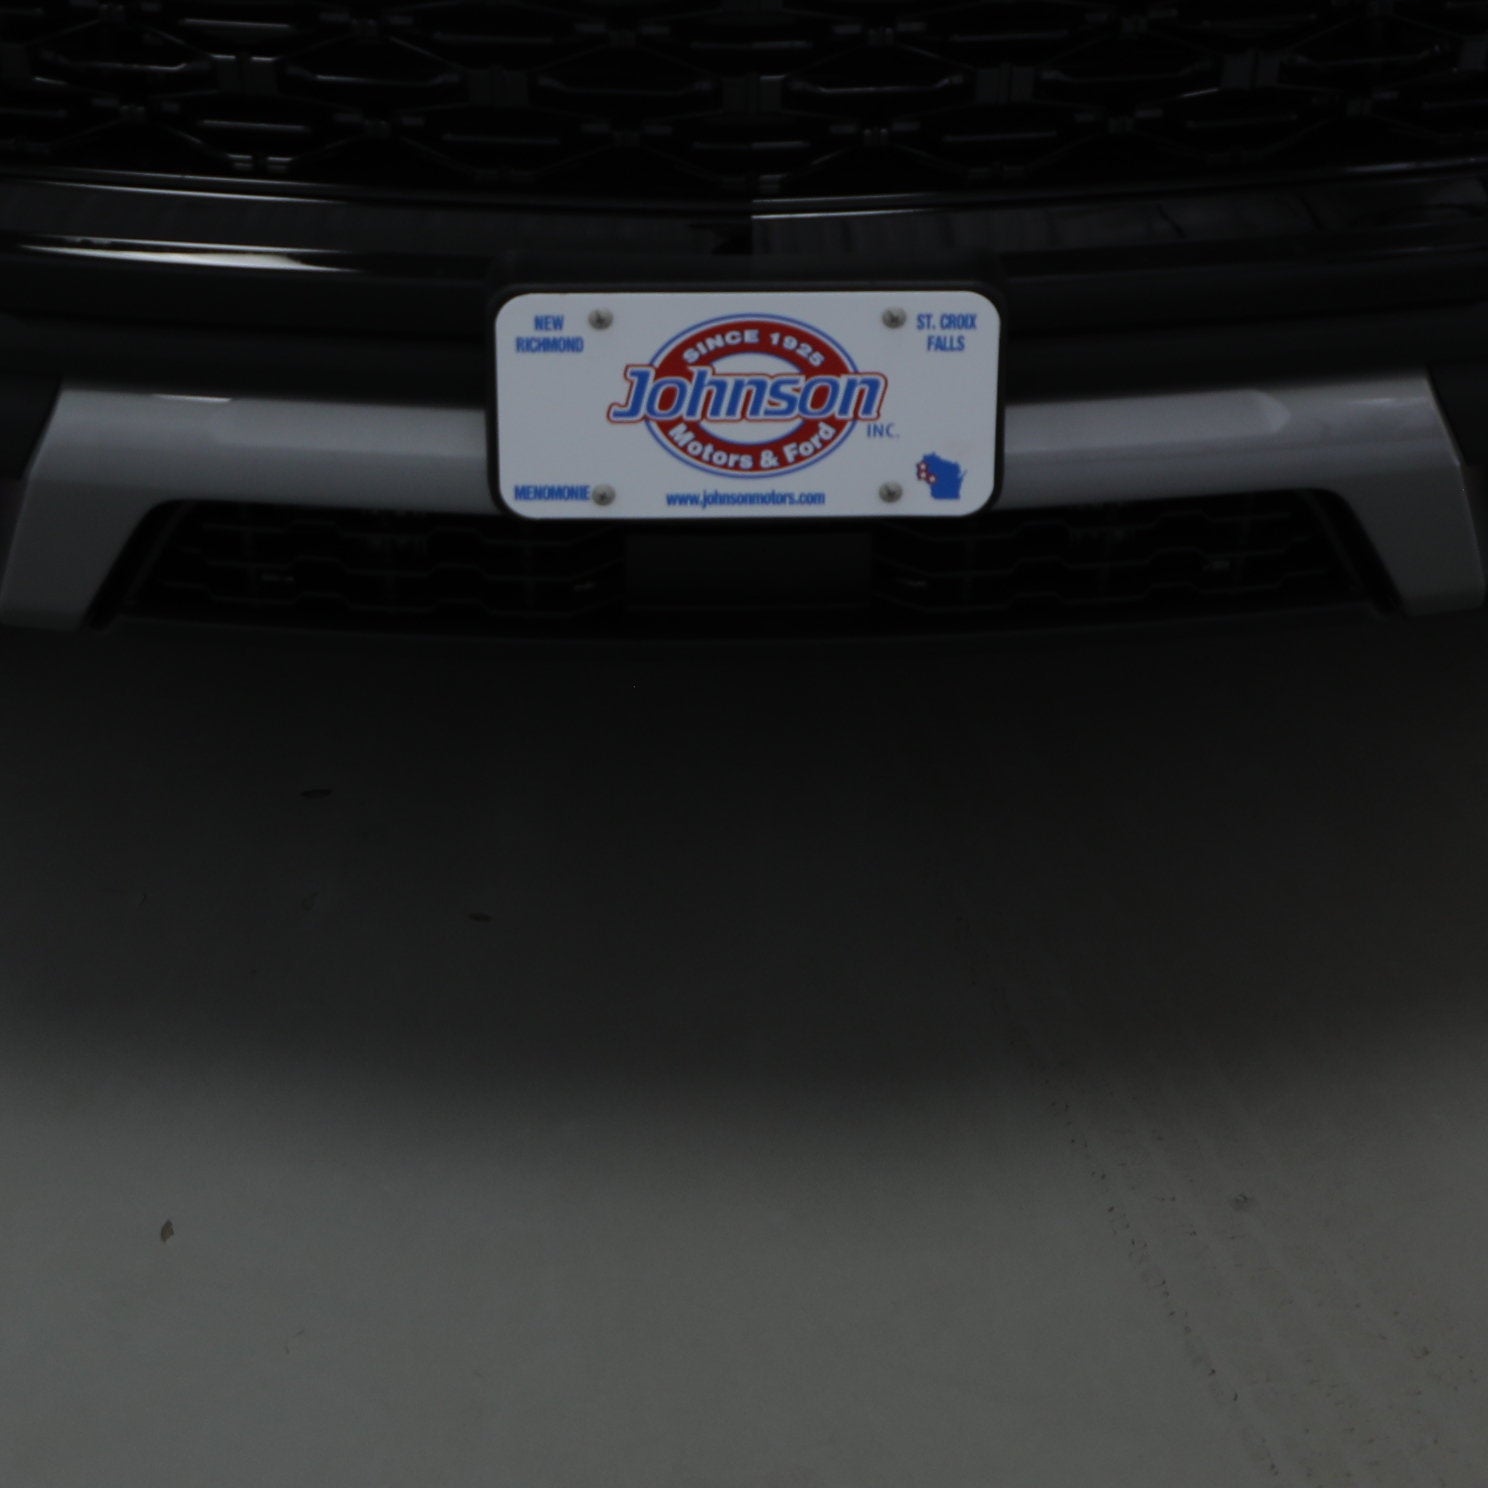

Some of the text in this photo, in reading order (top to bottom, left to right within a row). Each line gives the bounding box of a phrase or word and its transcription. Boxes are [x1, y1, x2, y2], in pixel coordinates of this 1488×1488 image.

[534, 315, 564, 331] NEW
[916, 313, 977, 330] ST. CROIX
[515, 337, 584, 353] RICHMOND
[682, 328, 826, 367] SINCE 1925
[926, 335, 965, 351] FALLS
[610, 368, 883, 419] Johnson
[866, 423, 900, 439] INC.
[667, 421, 837, 470] Motors & Ford
[514, 485, 590, 502] MENOMONIE
[665, 489, 826, 508] www.johnsonmotors.com
